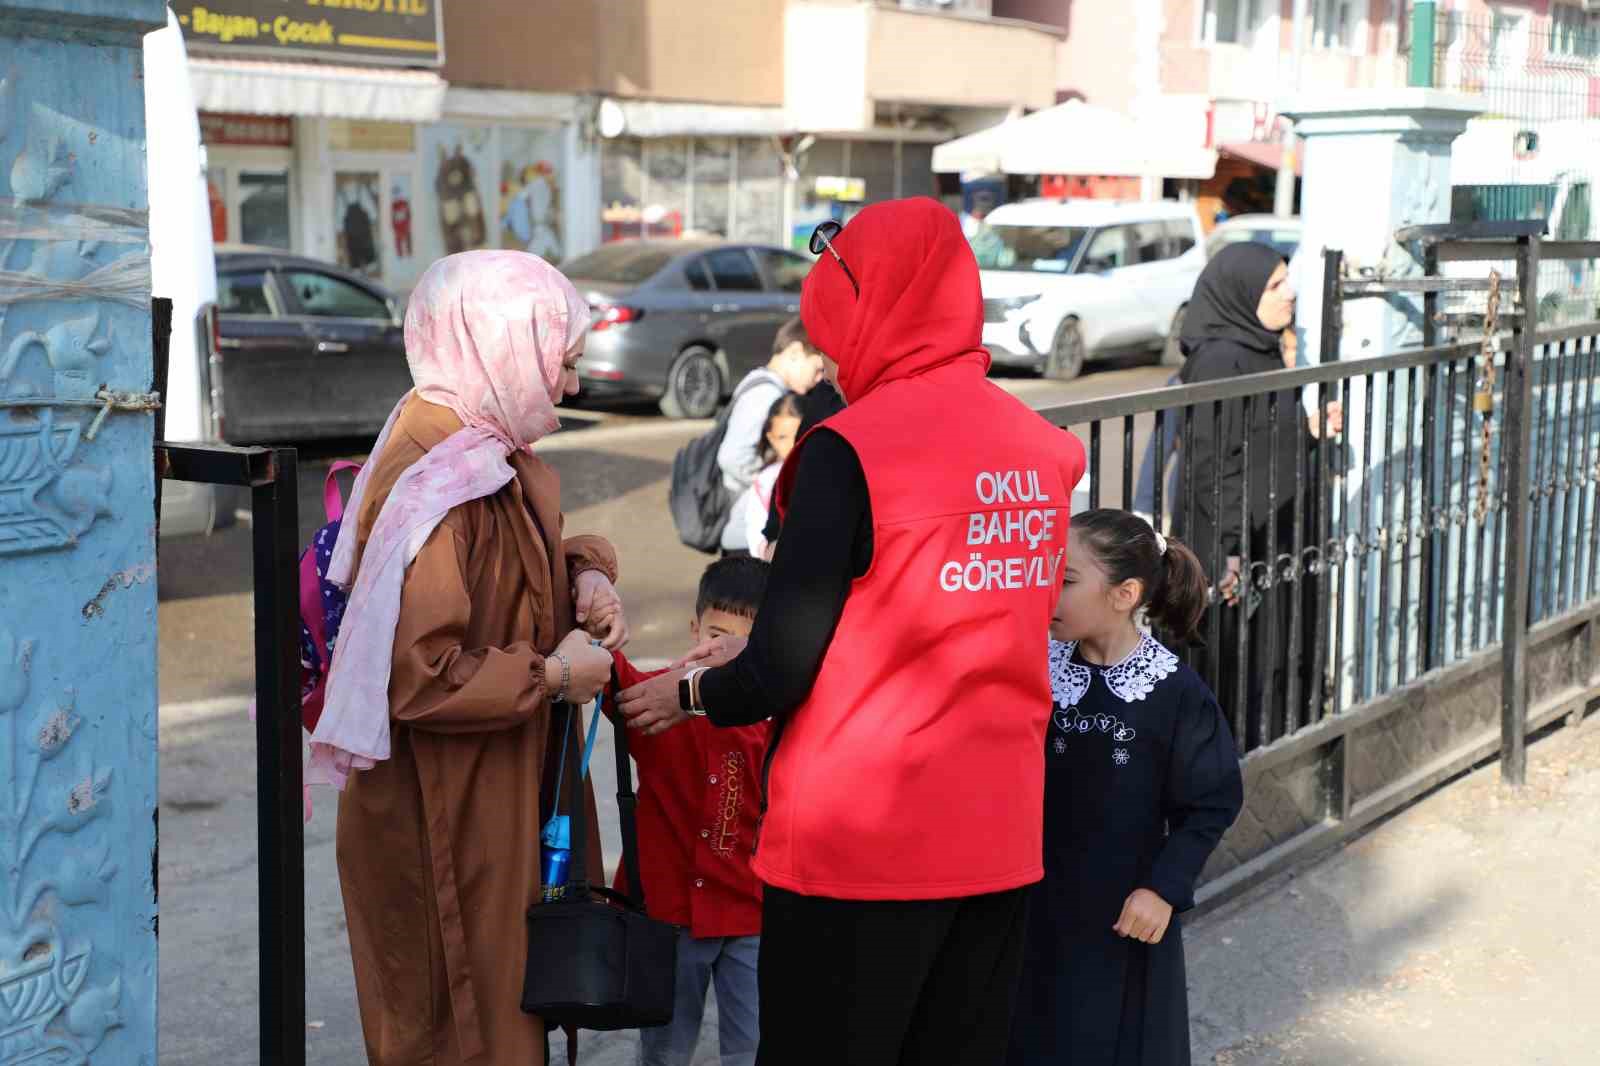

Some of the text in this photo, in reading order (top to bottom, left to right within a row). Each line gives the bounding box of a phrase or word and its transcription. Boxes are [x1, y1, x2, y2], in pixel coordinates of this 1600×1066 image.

[192, 7, 334, 45] Bayan Çocuk
[975, 470, 1049, 504] OKUL
[966, 509, 1057, 550] BAHÇE
